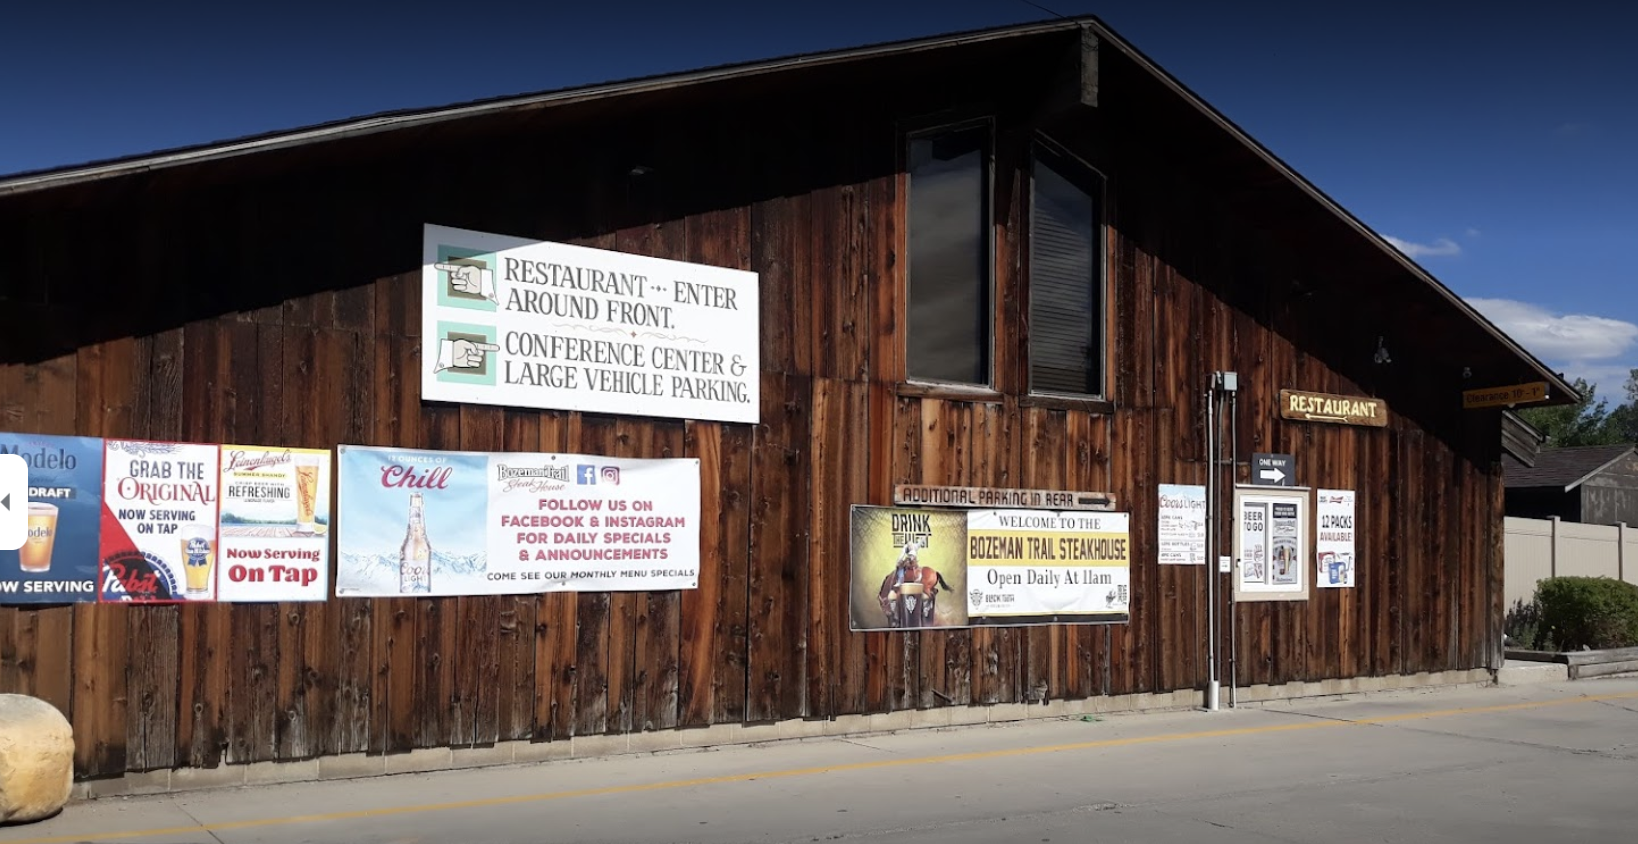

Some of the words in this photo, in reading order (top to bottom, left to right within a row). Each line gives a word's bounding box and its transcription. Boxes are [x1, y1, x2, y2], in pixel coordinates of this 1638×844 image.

[504, 257, 648, 298] RESTAURANT
[674, 280, 738, 311] ENTER
[505, 288, 598, 320] AROUND
[606, 300, 676, 330] FRONT.
[505, 330, 645, 368] CONFERENCE
[652, 346, 724, 376] CENTER
[730, 354, 748, 377] &
[504, 360, 578, 390] LARGE
[584, 367, 664, 397] VEHICLE
[671, 376, 751, 404] PARKING.
[1466, 391, 1509, 403] Clearance
[1289, 394, 1378, 418] RESTAURANT
[398, 455, 432, 463] OUNCES
[1259, 458, 1271, 466] ONE
[130, 459, 172, 478] GRAB
[177, 462, 204, 480] THE
[380, 464, 453, 490] Chill
[28, 487, 72, 498] DRAFT
[228, 485, 290, 499] REFRESHING
[904, 487, 976, 504] ADDITIONAL
[1046, 493, 1074, 507] REAR
[538, 499, 602, 511] FOLLOW
[608, 500, 627, 511] US
[632, 500, 653, 512] ON
[1184, 500, 1206, 509] LIGHT
[118, 508, 146, 520] NOW
[149, 510, 196, 521] SERVING
[1244, 511, 1263, 520] BEER
[137, 522, 154, 534] ON
[157, 523, 178, 535] TAP
[501, 516, 584, 528] FACEBOOK
[590, 516, 600, 528] &
[604, 516, 686, 528] INSTAGRAM
[892, 514, 931, 532] DRINK
[999, 515, 1057, 529] WELCOME
[1060, 517, 1075, 529] TO
[1078, 518, 1101, 530] THE
[1253, 522, 1263, 532] GO
[1322, 515, 1330, 528] 12
[1331, 515, 1352, 529] PACKS
[28, 526, 52, 538] odelo
[516, 532, 548, 544] FOR
[554, 532, 598, 544] DAILY
[603, 532, 671, 544] SPECIALS
[226, 548, 262, 559] Now
[264, 548, 320, 562] Serving
[518, 549, 529, 561] &
[534, 548, 668, 561] ANNOUNCEMENTS
[970, 536, 1023, 559] BOZEMAN
[1027, 537, 1056, 560] TRAIL
[1060, 538, 1126, 560] STEAKHOUSE
[102, 562, 160, 593] Pabst
[228, 564, 264, 582] On
[268, 564, 318, 586] Tap
[486, 572, 517, 581] COME
[520, 571, 540, 580] SEE
[544, 571, 567, 580] OUR
[570, 570, 617, 579] MONTHLY
[620, 570, 648, 578] MENU
[650, 569, 695, 578] SPECIALS
[987, 569, 1022, 588] Open
[1027, 568, 1060, 588] Daily
[1064, 570, 1080, 584] At
[23, 580, 94, 593] SERVING
